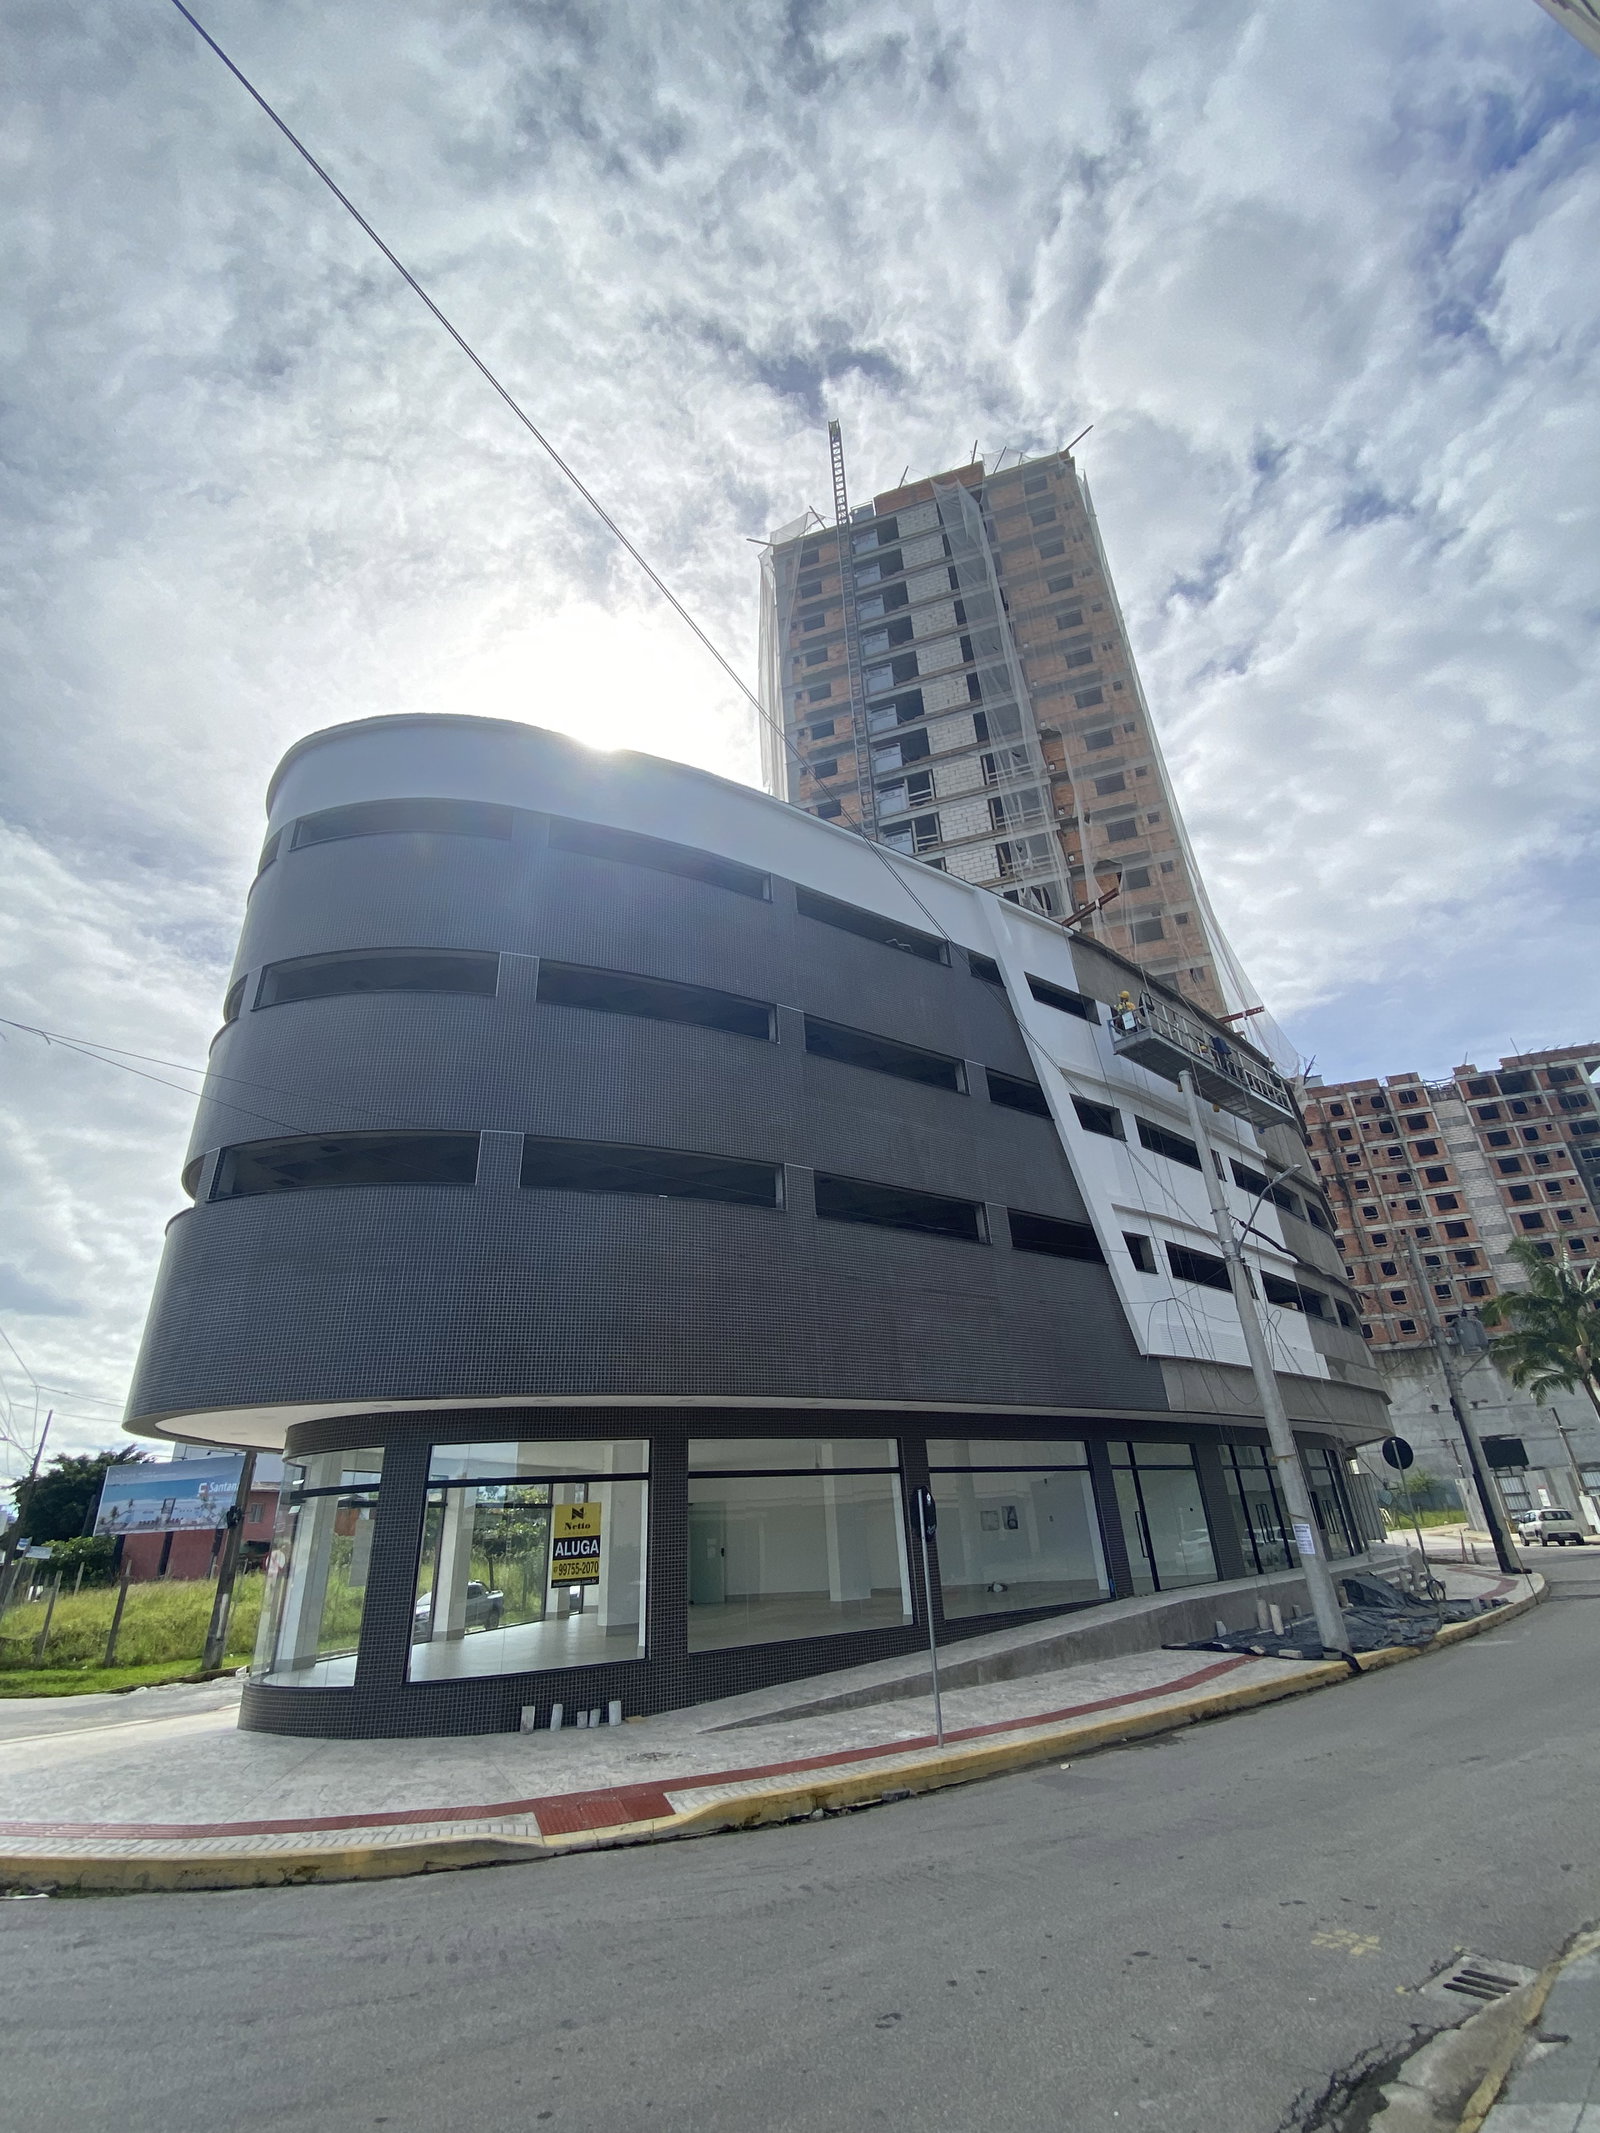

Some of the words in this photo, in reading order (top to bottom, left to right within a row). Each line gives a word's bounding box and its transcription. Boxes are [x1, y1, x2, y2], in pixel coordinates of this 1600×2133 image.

[209, 1482, 239, 1492] Santan
[564, 1522, 591, 1530] Netto
[555, 1540, 599, 1557] ALUGA
[558, 1561, 599, 1576] 99755-2070
